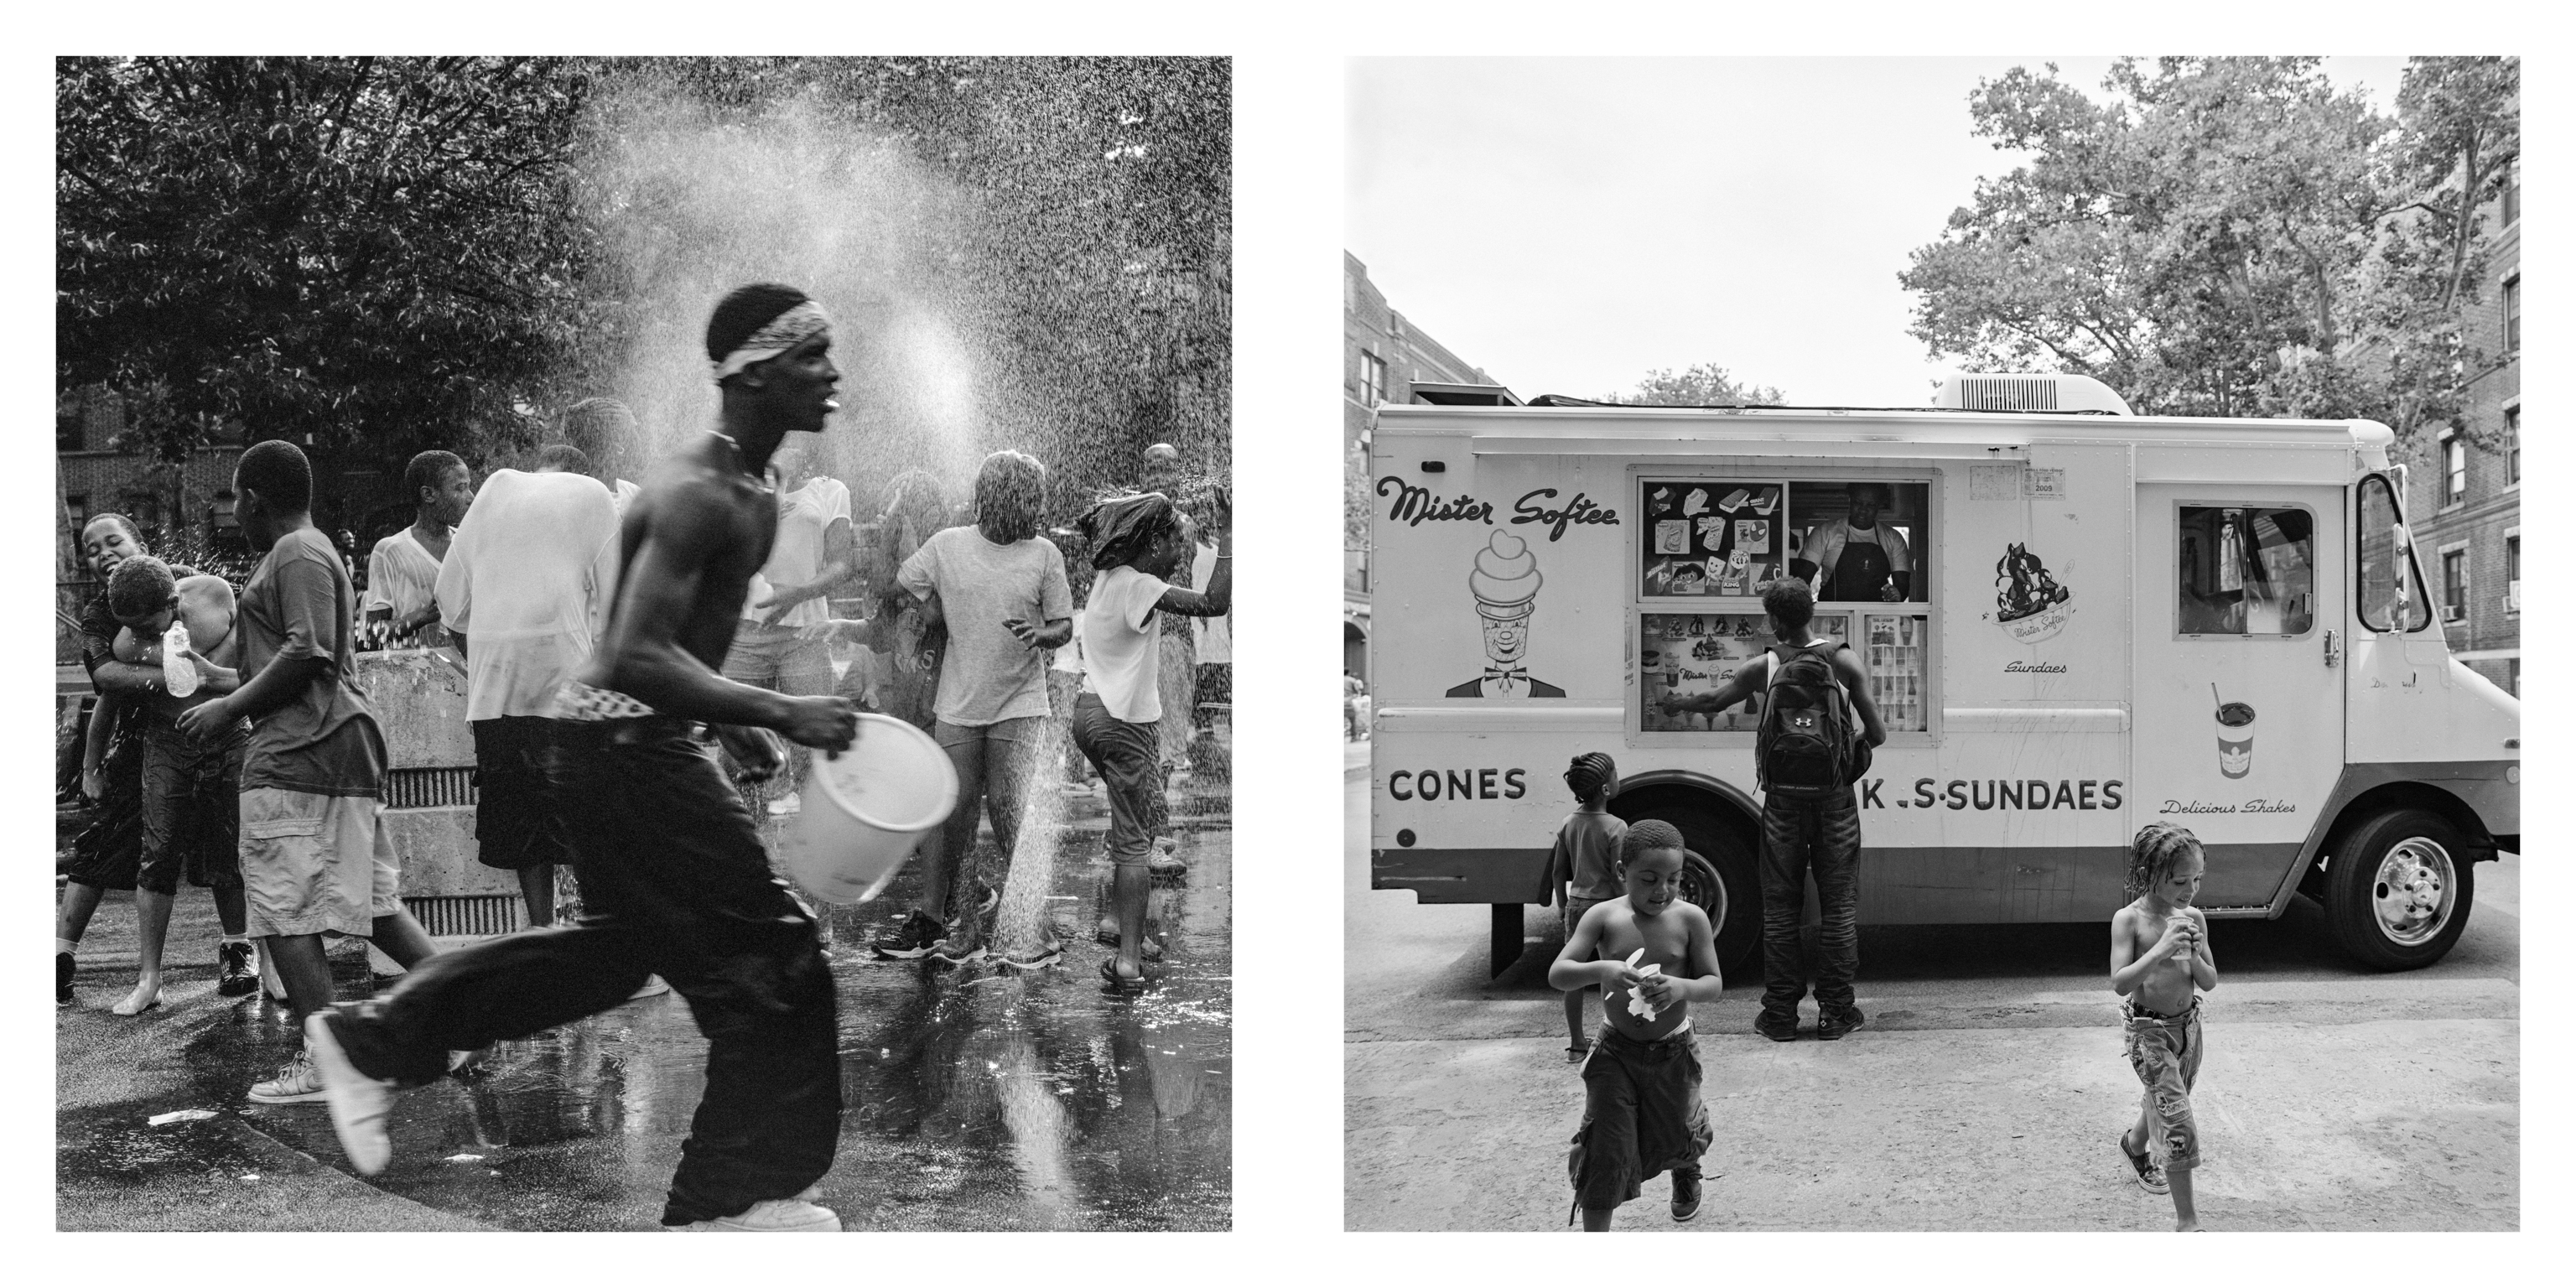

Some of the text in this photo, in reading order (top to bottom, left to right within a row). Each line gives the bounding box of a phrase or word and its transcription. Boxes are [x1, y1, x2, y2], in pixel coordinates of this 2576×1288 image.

[1377, 475, 1620, 542] Mister Softee
[1646, 561, 1668, 579] Bullet
[2014, 615, 2065, 638] Mister Softee
[1680, 667, 1707, 681] Mister
[2004, 661, 2067, 673] Sundaes
[1389, 767, 1526, 801] CONES
[2159, 798, 2296, 814] Delicious Shakes
